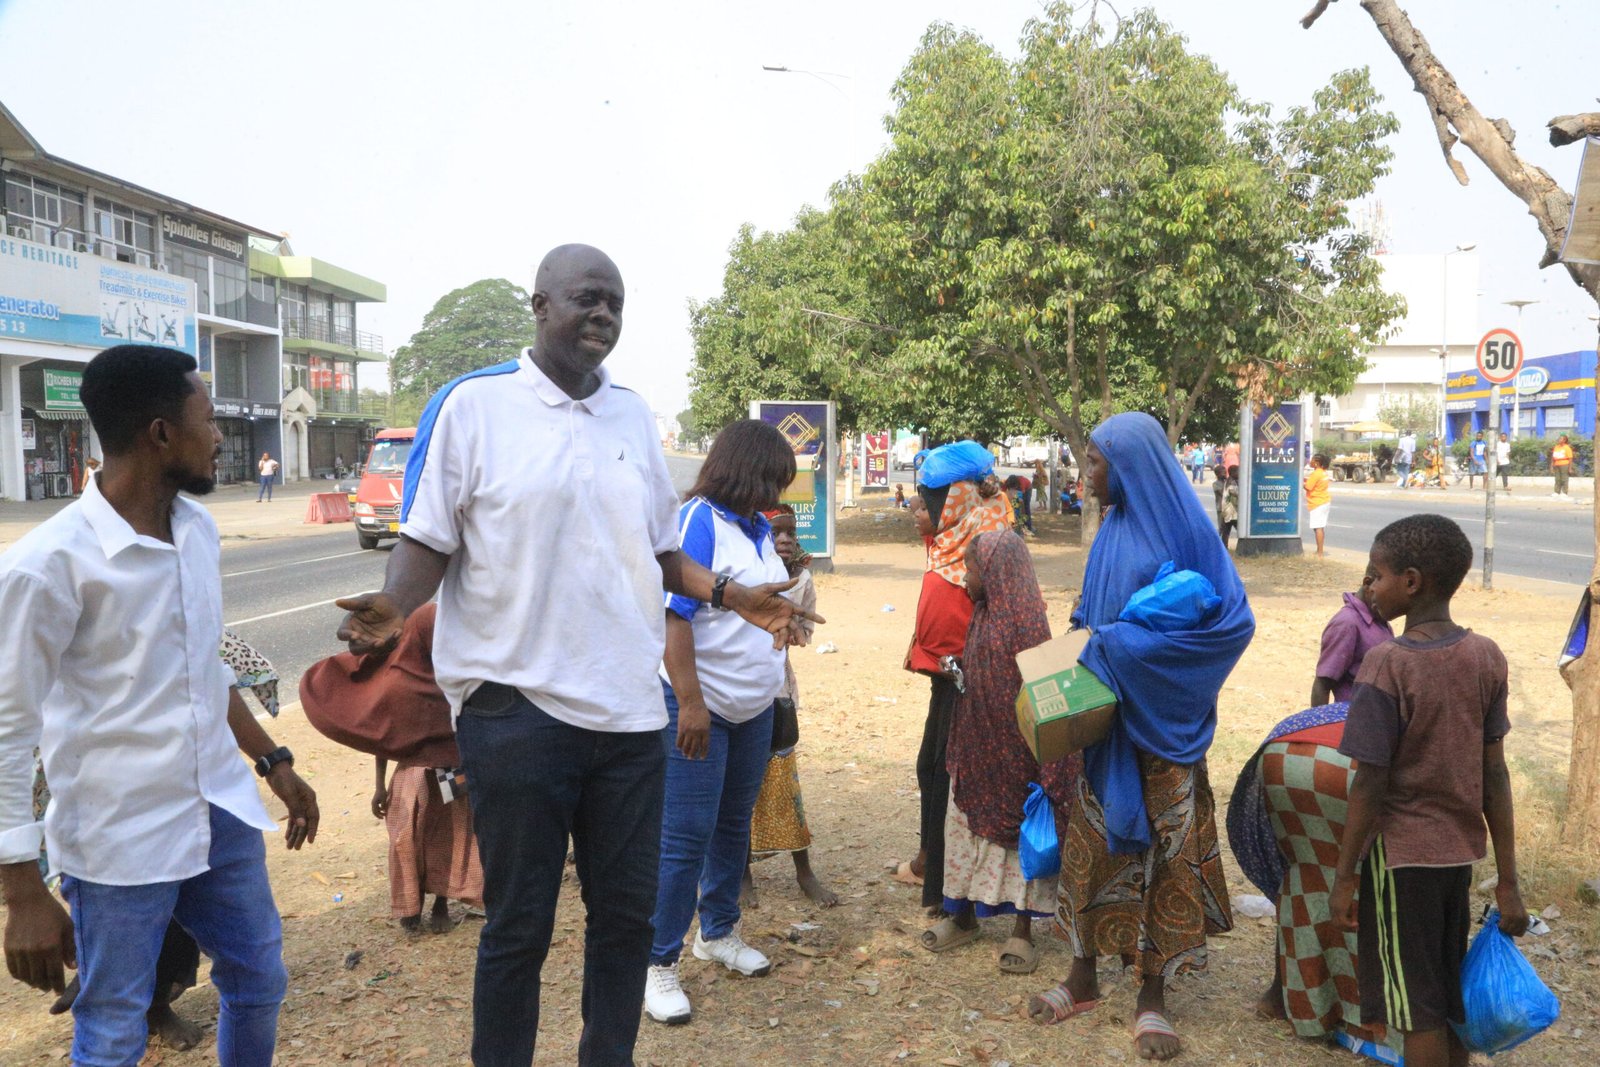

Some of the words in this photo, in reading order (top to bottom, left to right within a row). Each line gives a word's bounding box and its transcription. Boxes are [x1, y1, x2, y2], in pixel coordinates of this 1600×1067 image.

[163, 214, 209, 244] Spindles
[22, 244, 79, 270] HERITAGE
[99, 279, 136, 297] Treadmills
[137, 288, 143, 297] &
[143, 288, 170, 303] Exercise
[1485, 341, 1516, 370] 50
[1257, 491, 1290, 501] LUXURY
